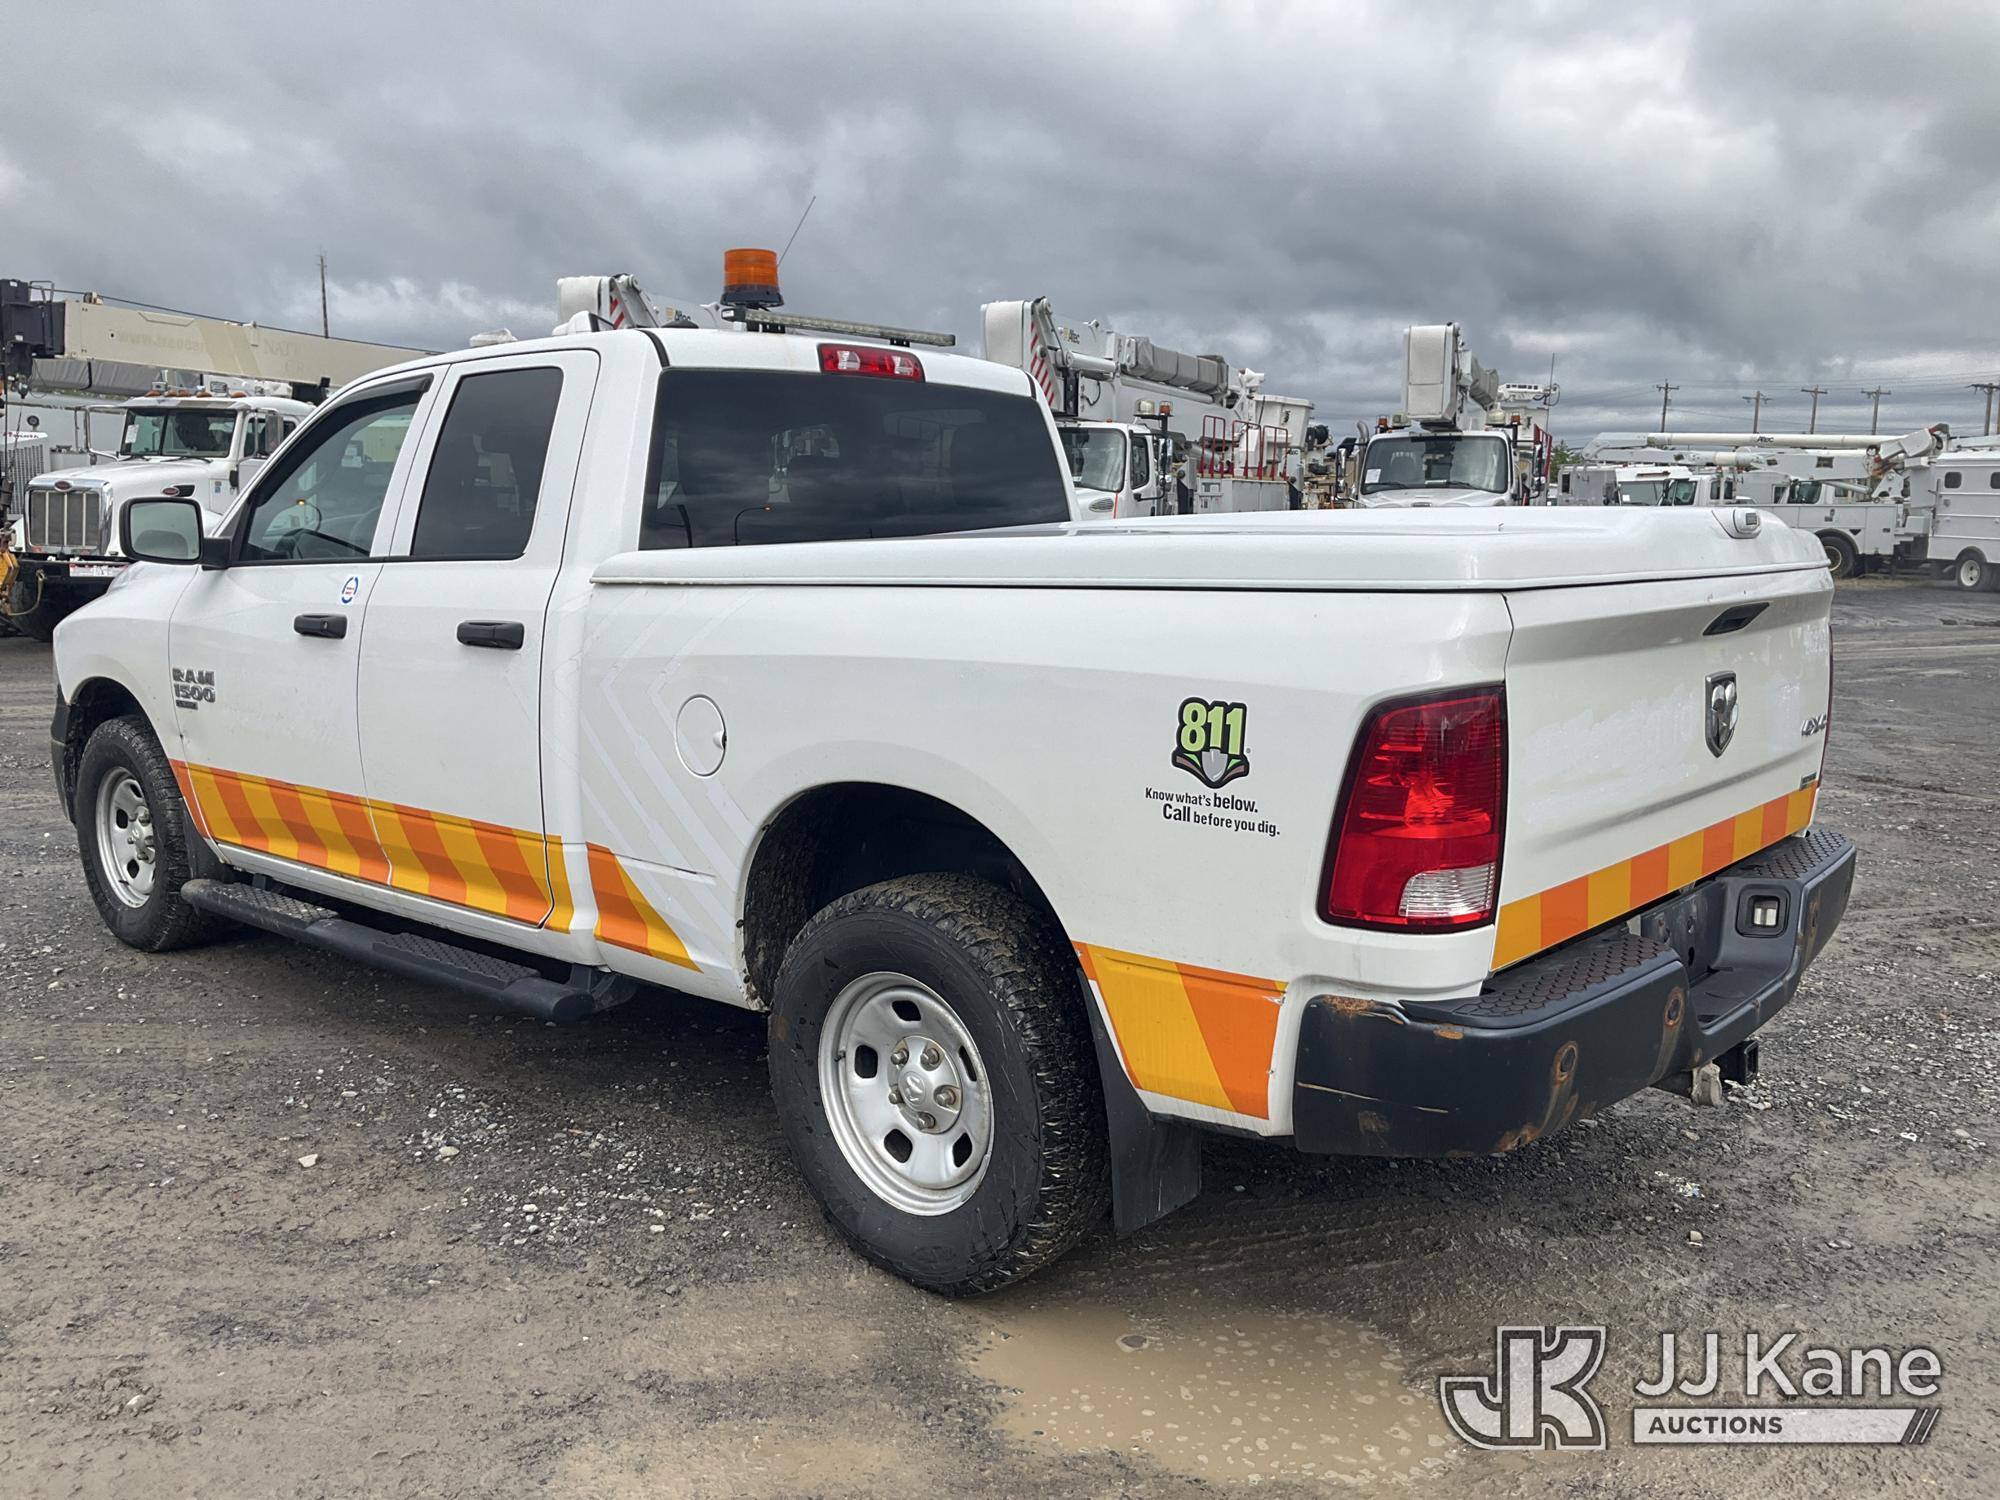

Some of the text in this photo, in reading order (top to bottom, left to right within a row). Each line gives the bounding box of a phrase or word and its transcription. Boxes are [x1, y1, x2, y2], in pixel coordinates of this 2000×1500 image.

[172, 667, 215, 686] RAM
[173, 683, 216, 703] 1500
[1180, 700, 1245, 756] 811
[1145, 787, 1258, 813] Know what's below.
[1163, 803, 1280, 837] Call before you dig.
